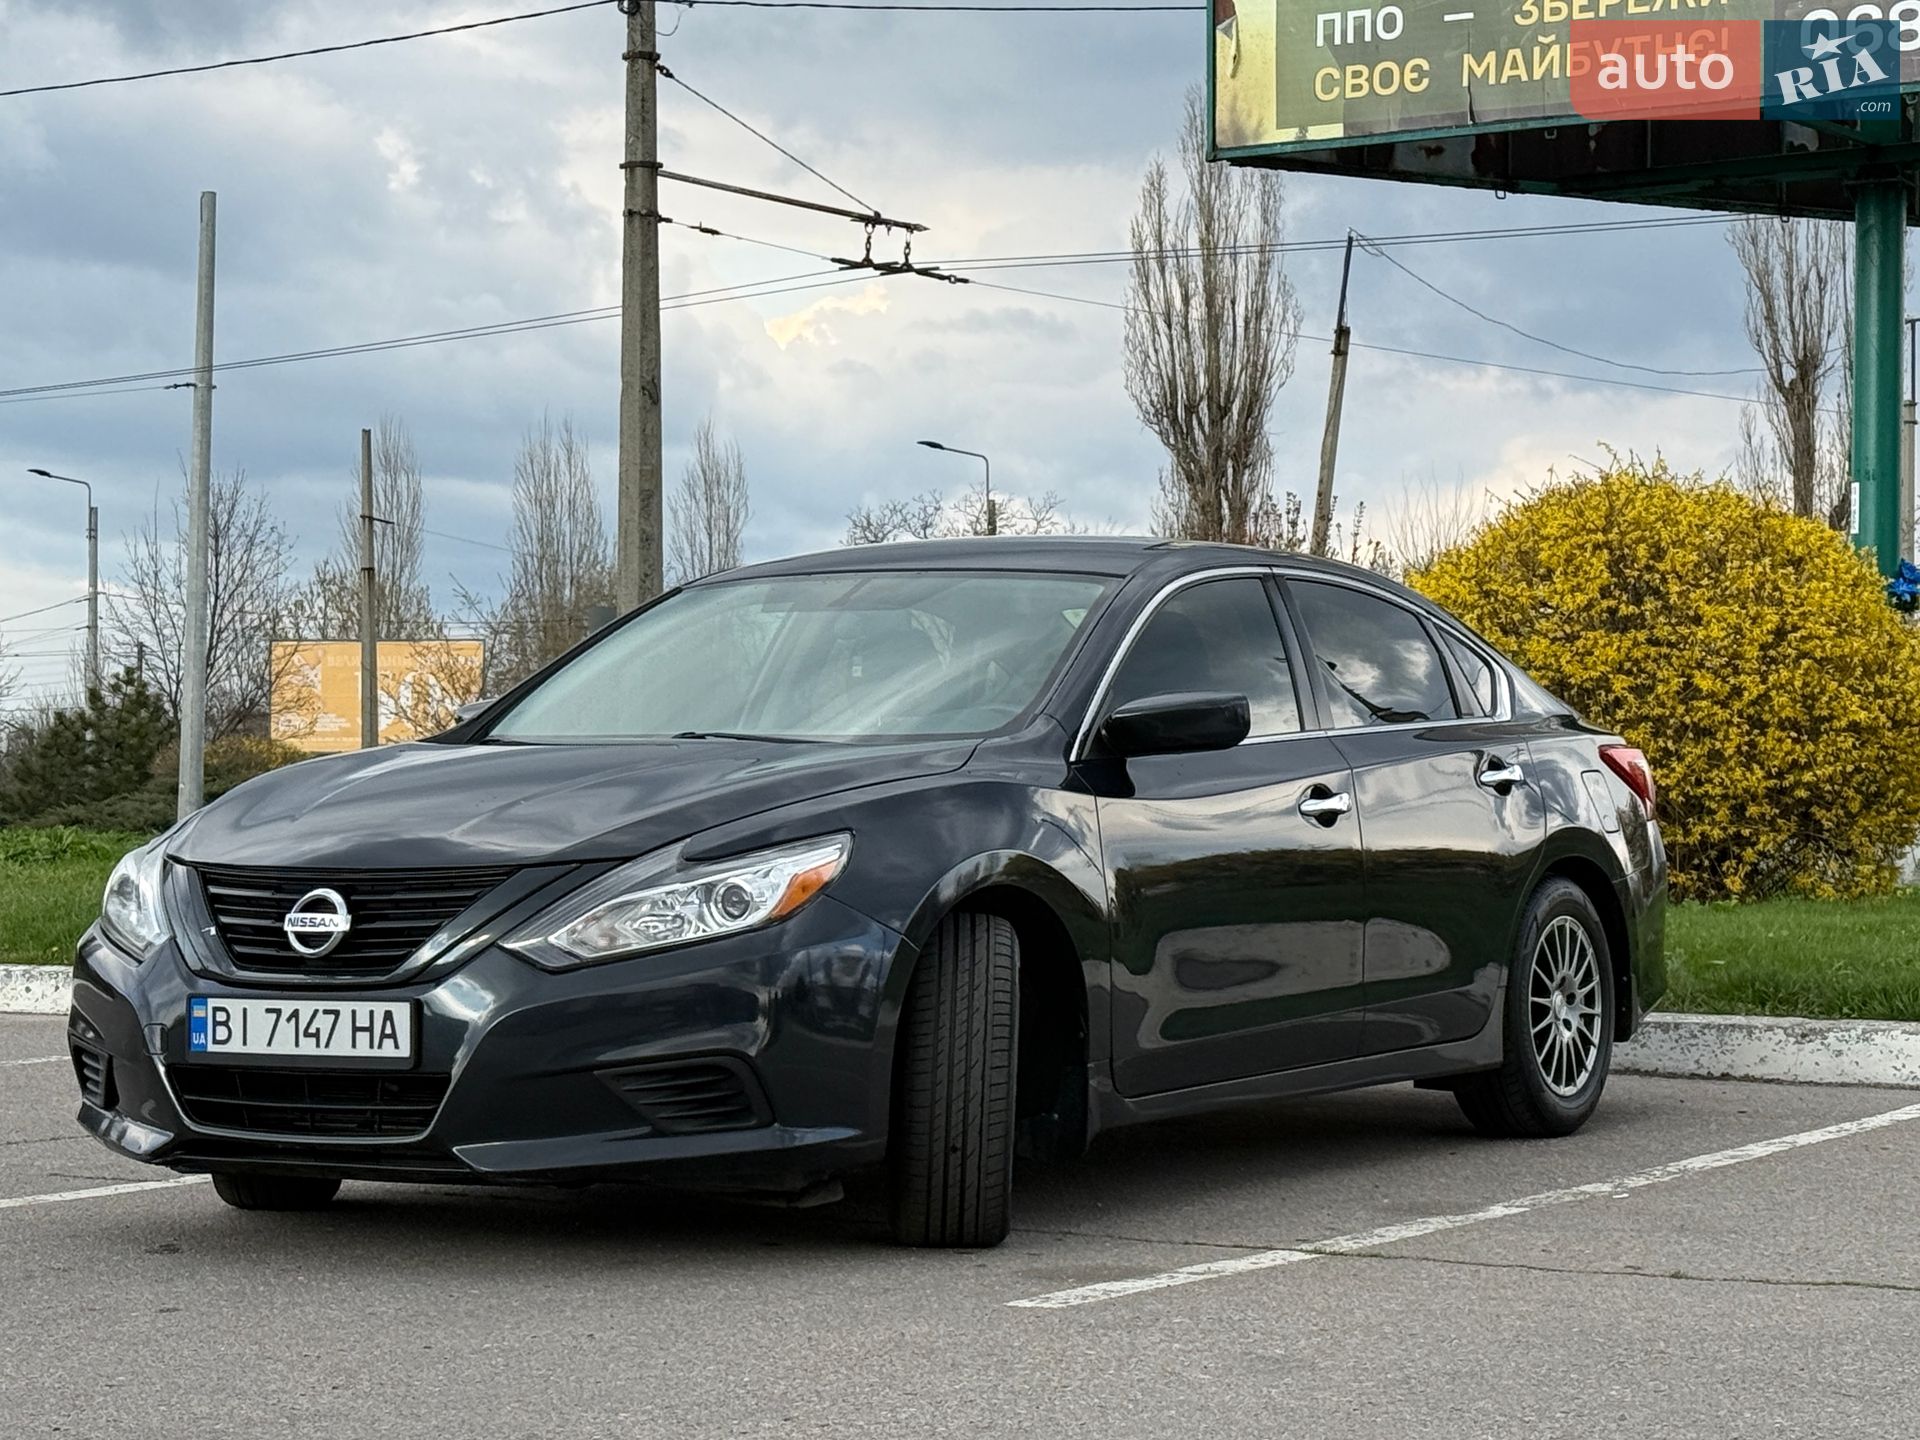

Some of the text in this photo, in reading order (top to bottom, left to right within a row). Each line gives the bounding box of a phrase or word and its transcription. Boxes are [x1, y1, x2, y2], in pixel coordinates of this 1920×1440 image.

[1316, 6, 1404, 47] ППО
[1314, 58, 1431, 102] СВОЄ
[286, 916, 339, 928] NISSAN
[192, 1032, 206, 1046] UA
[211, 1006, 401, 1050] BI 7147 HA
